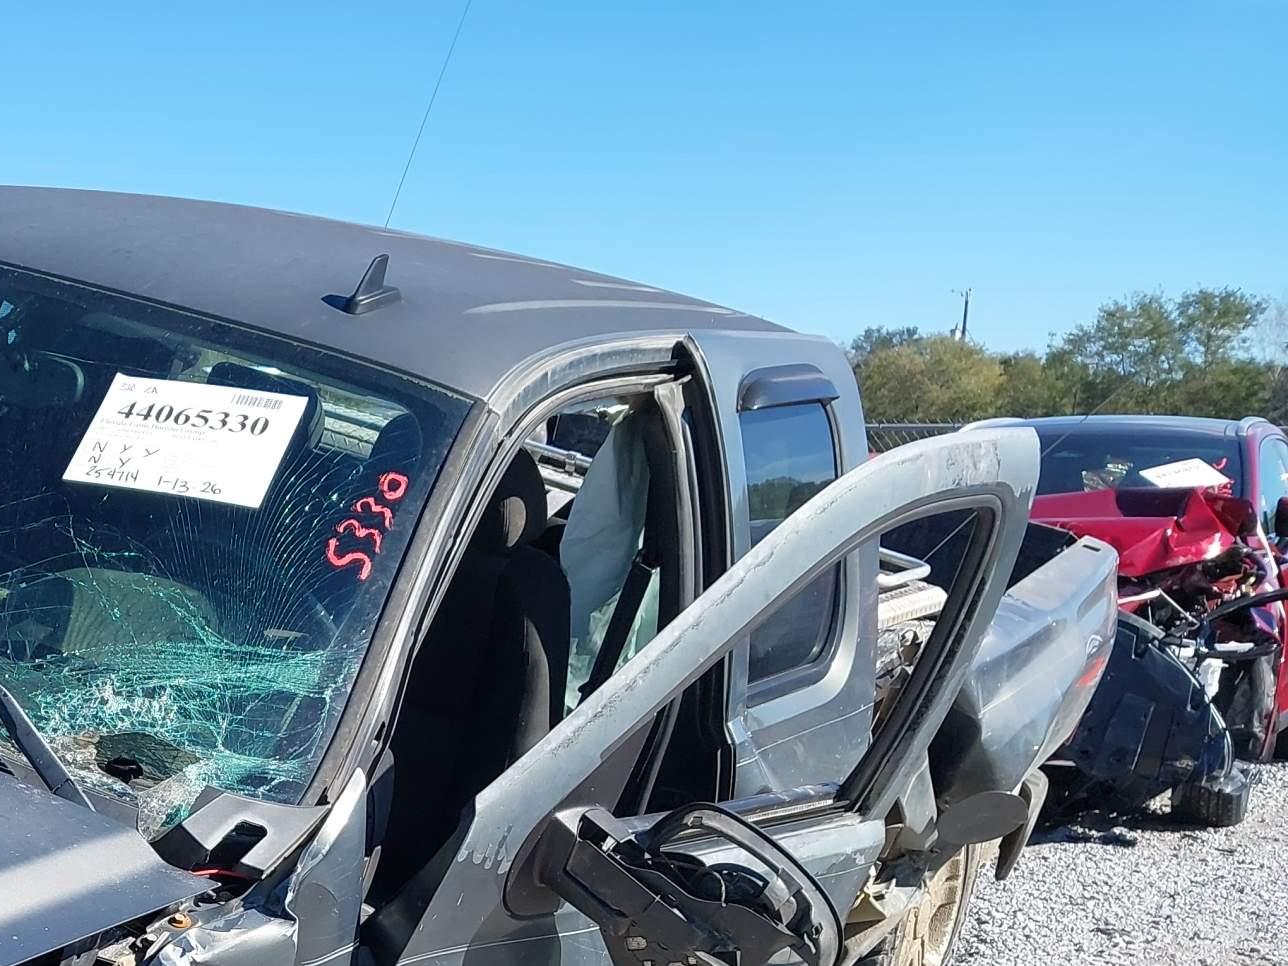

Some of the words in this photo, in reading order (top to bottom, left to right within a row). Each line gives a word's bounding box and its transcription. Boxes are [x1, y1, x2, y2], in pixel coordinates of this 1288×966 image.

[117, 401, 270, 437] 44065330
[92, 441, 109, 453] N
[326, 471, 409, 581] 5330
